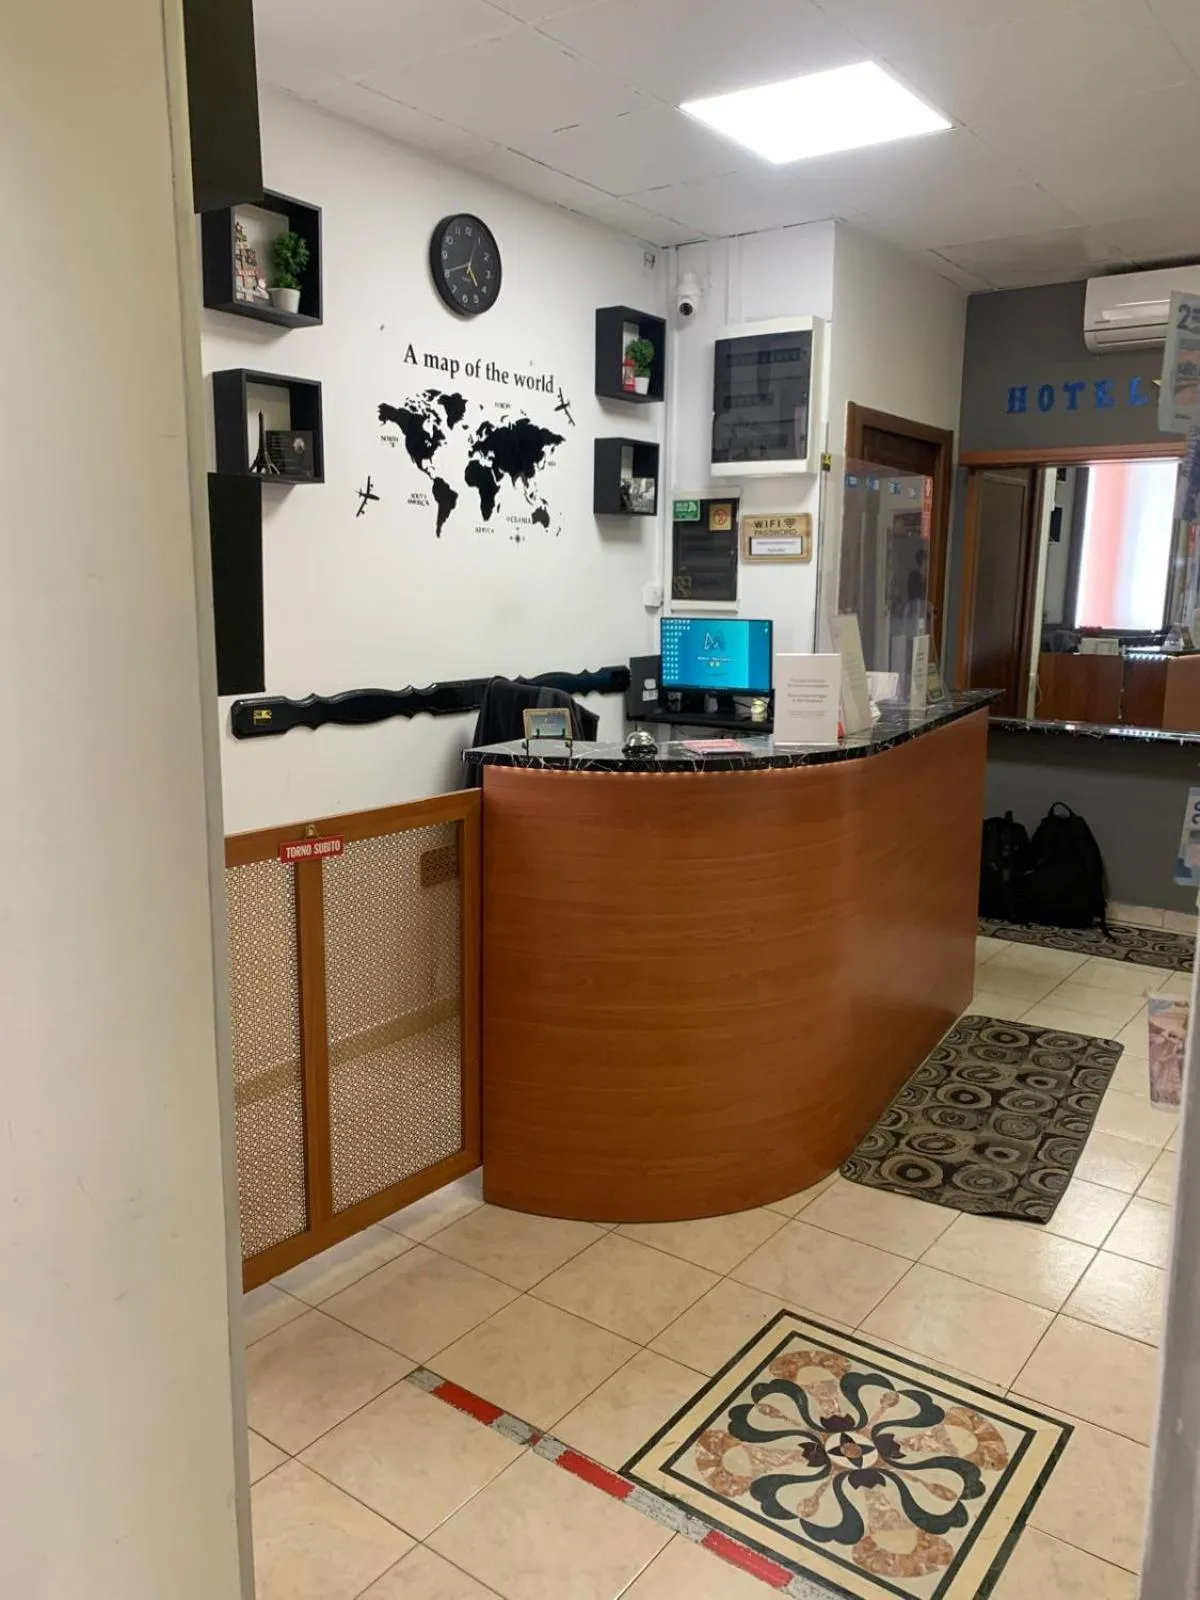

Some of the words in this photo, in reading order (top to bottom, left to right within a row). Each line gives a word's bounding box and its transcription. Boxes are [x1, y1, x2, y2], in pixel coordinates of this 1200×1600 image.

[403, 343, 418, 365] A
[423, 352, 460, 379] map
[464, 358, 482, 379] of
[485, 361, 510, 385] the
[513, 372, 555, 394] world
[1007, 377, 1150, 414] HOTEL
[753, 519, 781, 528] WIFI
[286, 844, 312, 859] TORNO
[313, 840, 341, 854] SUBITO
